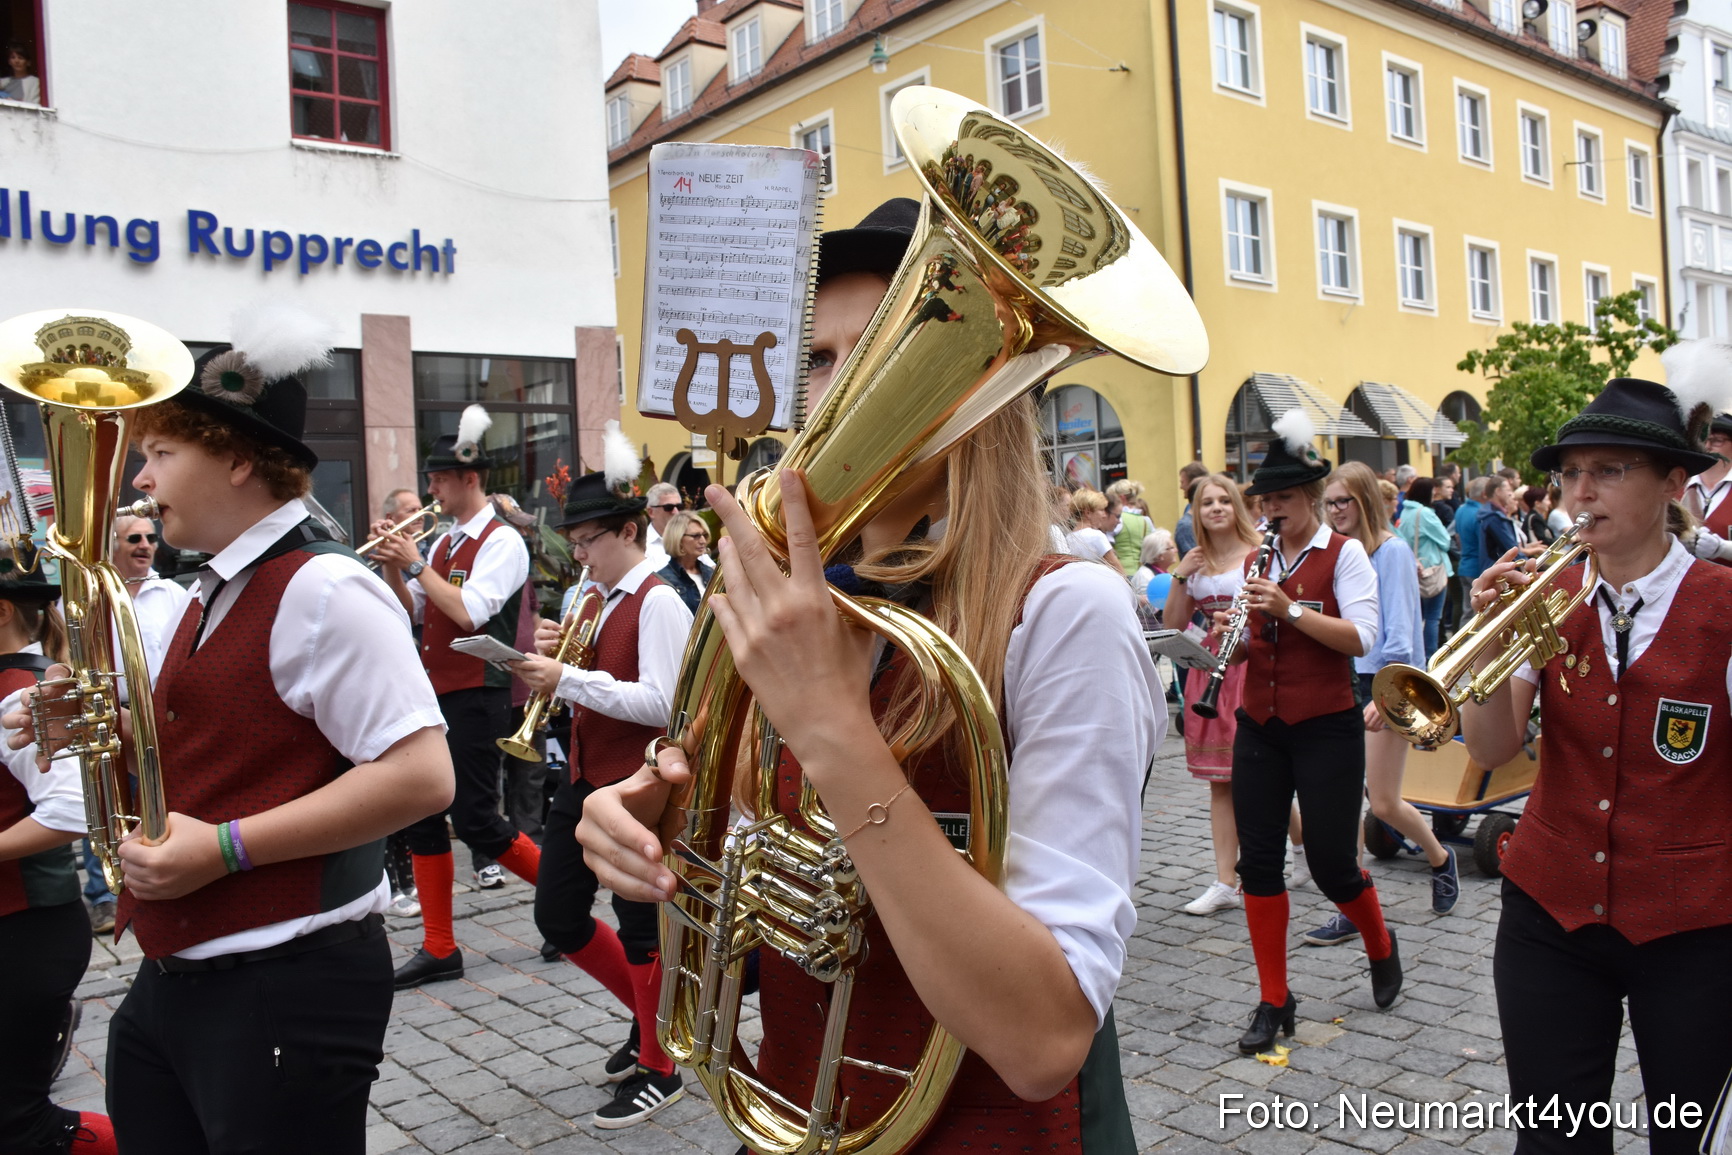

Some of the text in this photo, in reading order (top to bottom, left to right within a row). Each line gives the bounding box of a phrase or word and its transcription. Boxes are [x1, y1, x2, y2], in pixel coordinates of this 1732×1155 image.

[673, 176, 692, 194] 14
[698, 173, 744, 184] NEUE ZEIT
[187, 209, 457, 275] Rupprecht
[1661, 703, 1708, 718] BLASKAPELLE
[1658, 743, 1697, 761] PILSACH
